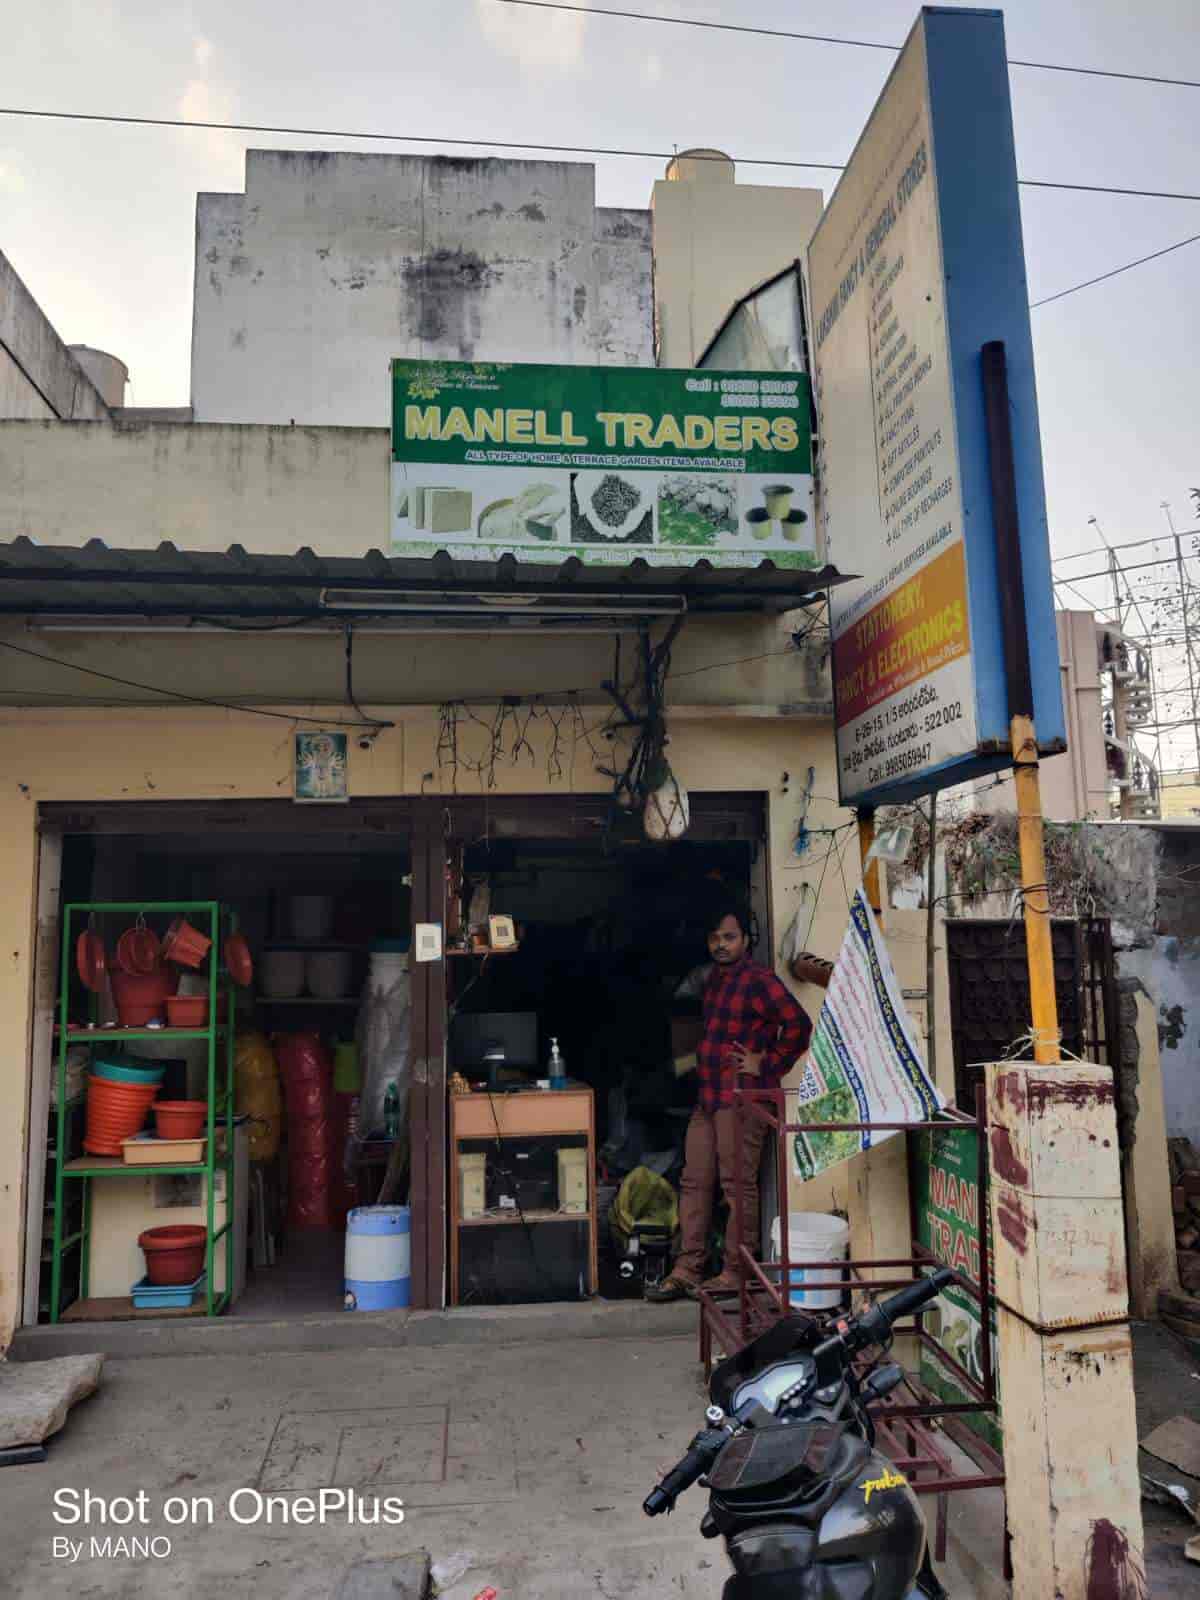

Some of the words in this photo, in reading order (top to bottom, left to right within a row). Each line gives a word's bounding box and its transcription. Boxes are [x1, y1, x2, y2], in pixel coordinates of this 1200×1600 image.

[865, 193, 896, 266] GENERAL
[897, 139, 927, 212] STORES
[404, 404, 588, 447] MANELL
[596, 411, 799, 452] TRADERS
[465, 448, 487, 462] ALL
[487, 450, 513, 462] TYPE
[529, 452, 561, 464] HOME
[571, 453, 619, 466] TERRACE
[620, 455, 660, 466] GARDEN
[661, 455, 691, 467] ITEMS
[691, 456, 746, 469] AVAILABLE
[920, 475, 952, 514] RECHARGES
[903, 544, 925, 571] SERVICES
[925, 520, 952, 552] AVAILABLE
[877, 599, 962, 678] ELECTRONICS
[924, 711, 941, 734] 522
[942, 700, 961, 725] 002
[929, 1164, 978, 1229] MAN
[927, 1210, 981, 1286] TRAD
